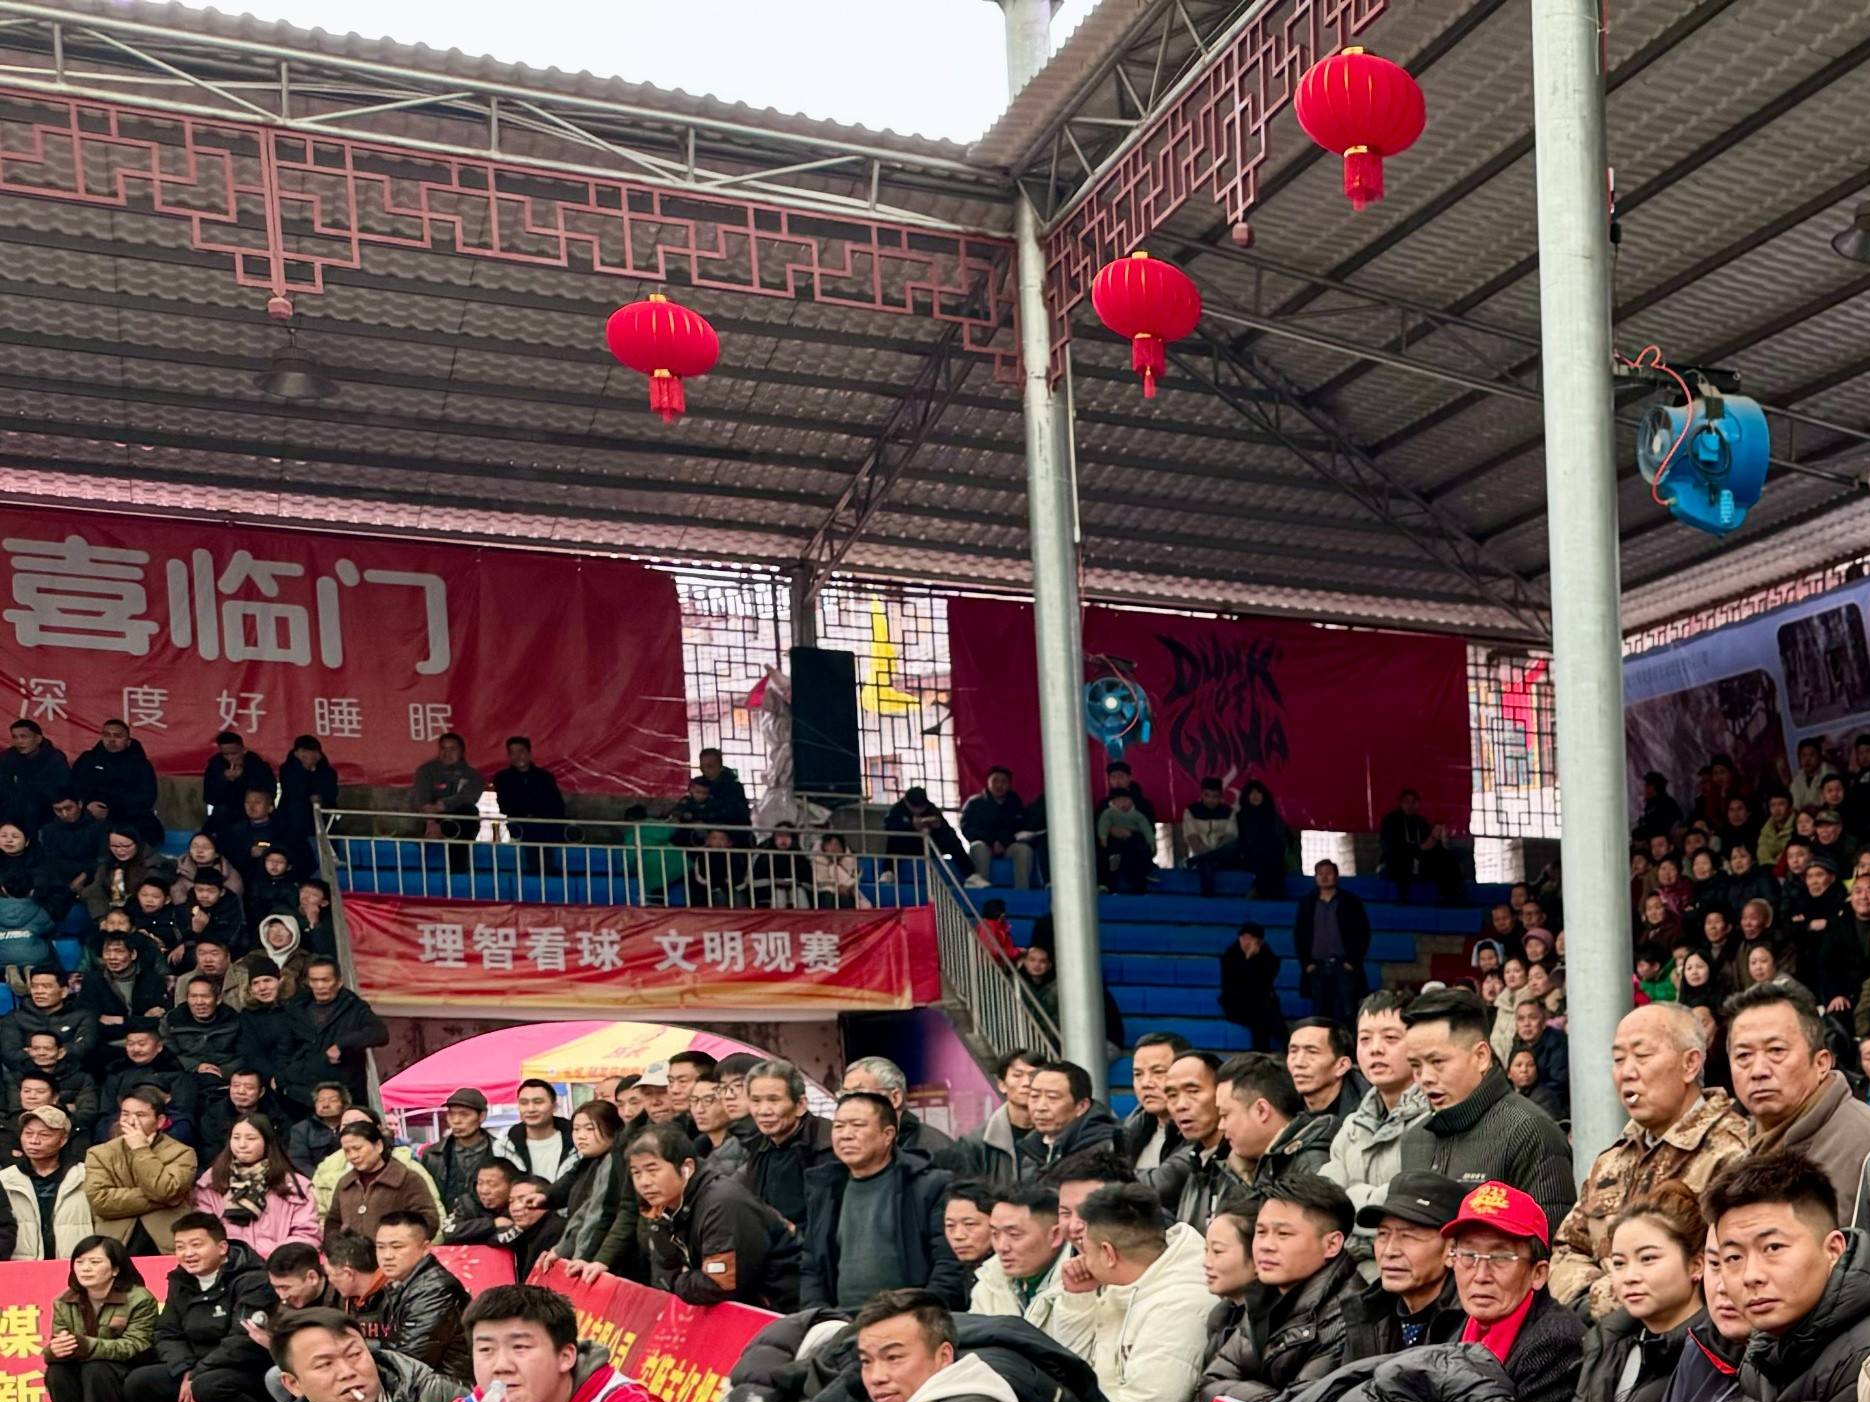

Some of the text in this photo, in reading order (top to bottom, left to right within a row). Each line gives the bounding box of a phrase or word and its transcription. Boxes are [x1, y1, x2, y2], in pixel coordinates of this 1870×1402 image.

[3, 535, 452, 676] 喜临门
[1155, 630, 1286, 711] DUNK
[18, 677, 454, 742] 深度好睡眠
[417, 922, 842, 976] 理智看球 文明观赛
